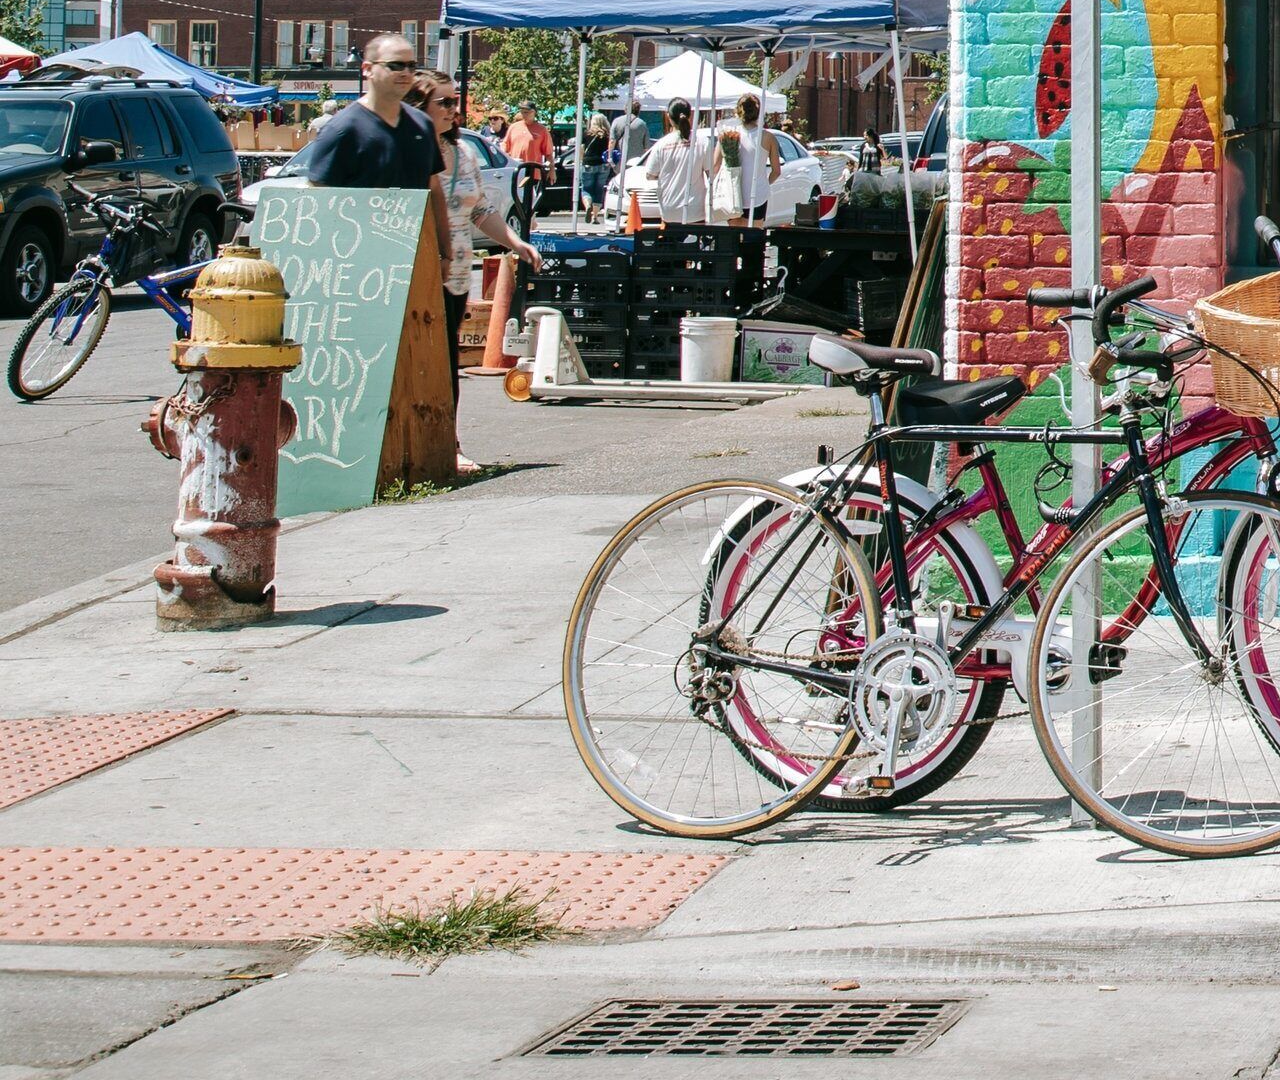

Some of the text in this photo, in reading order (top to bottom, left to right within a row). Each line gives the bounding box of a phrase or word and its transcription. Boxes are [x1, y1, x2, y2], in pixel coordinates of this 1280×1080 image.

[260, 195, 363, 259] BB'S
[358, 263, 414, 306] OF
[284, 302, 360, 344] THE
